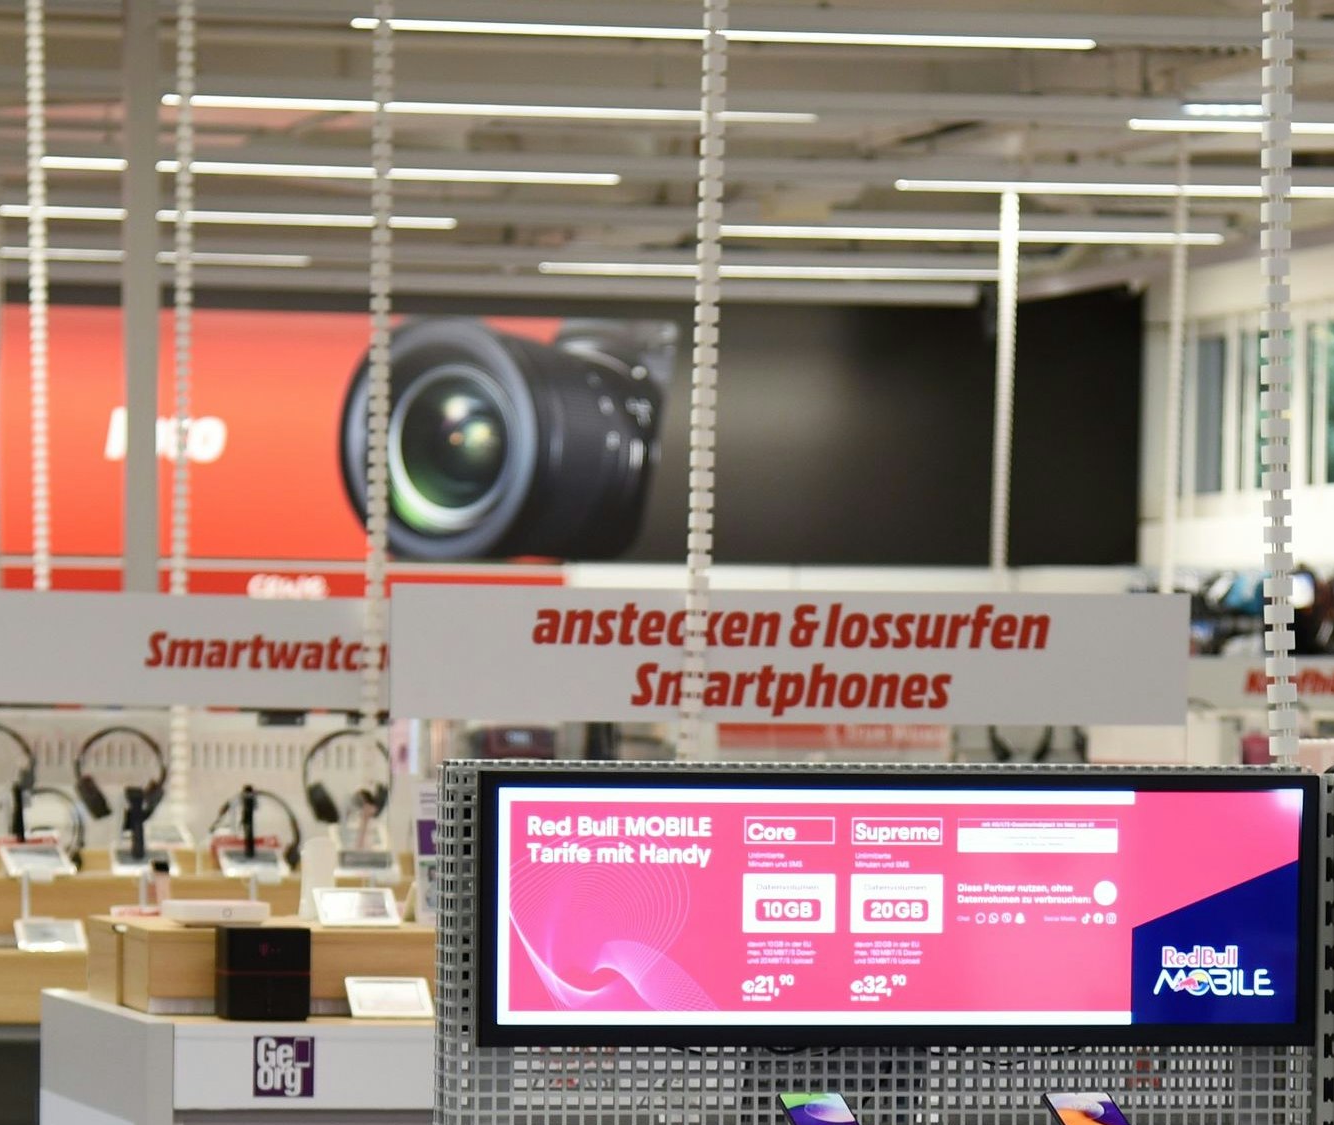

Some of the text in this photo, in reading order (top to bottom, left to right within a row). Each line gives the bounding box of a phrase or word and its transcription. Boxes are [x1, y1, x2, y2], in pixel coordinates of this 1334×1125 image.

[791, 604, 818, 648] &
[824, 604, 1051, 650] lossurfen
[527, 816, 712, 837] Red Bull MOBILE
[747, 822, 797, 841] Core
[855, 822, 940, 843] Supreme
[526, 842, 711, 868] Tarife mit Handy
[1153, 969, 1275, 996] MOBILE
